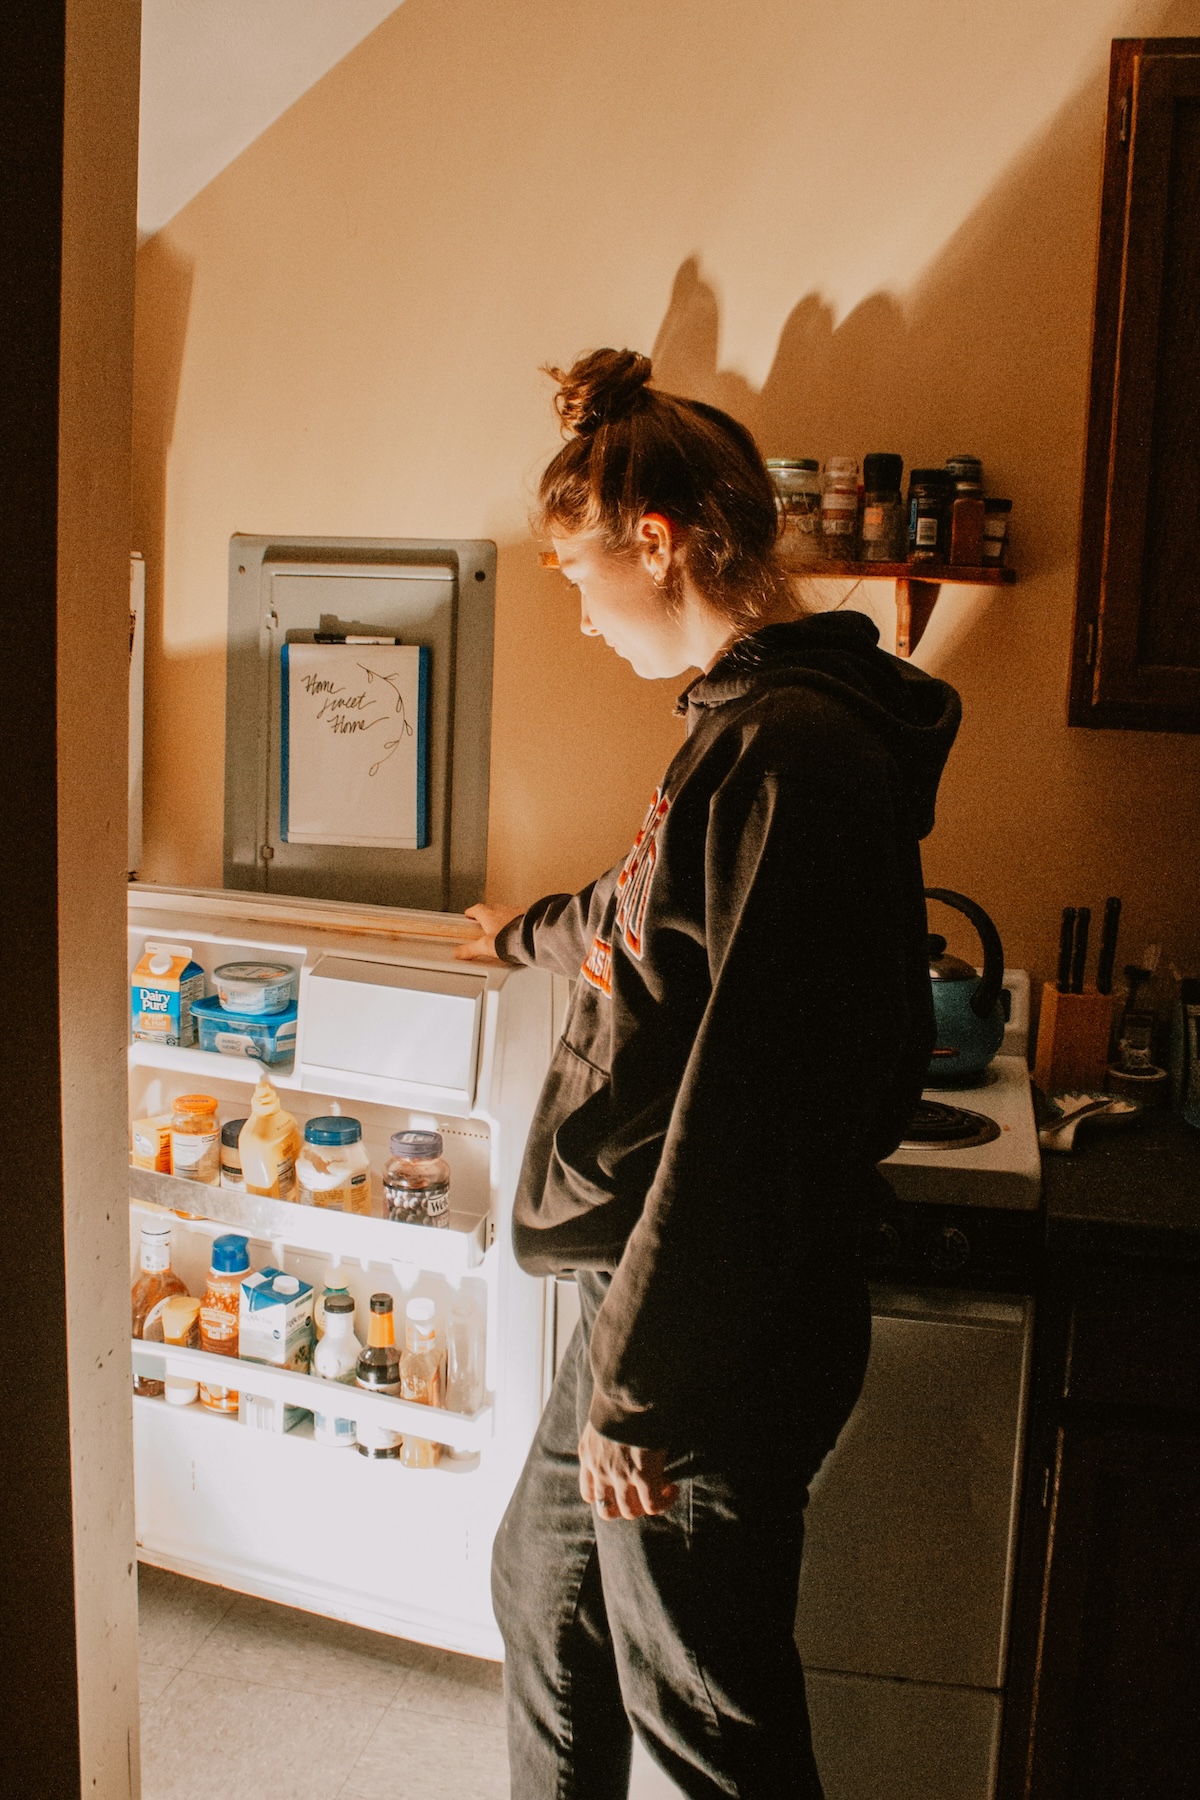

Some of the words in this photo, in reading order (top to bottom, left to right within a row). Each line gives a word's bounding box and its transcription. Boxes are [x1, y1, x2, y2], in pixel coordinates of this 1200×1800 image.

[301, 673, 346, 695] Home
[327, 715, 390, 734] Home
[140, 989, 171, 1004] Dairy
[142, 999, 168, 1012] Pure
